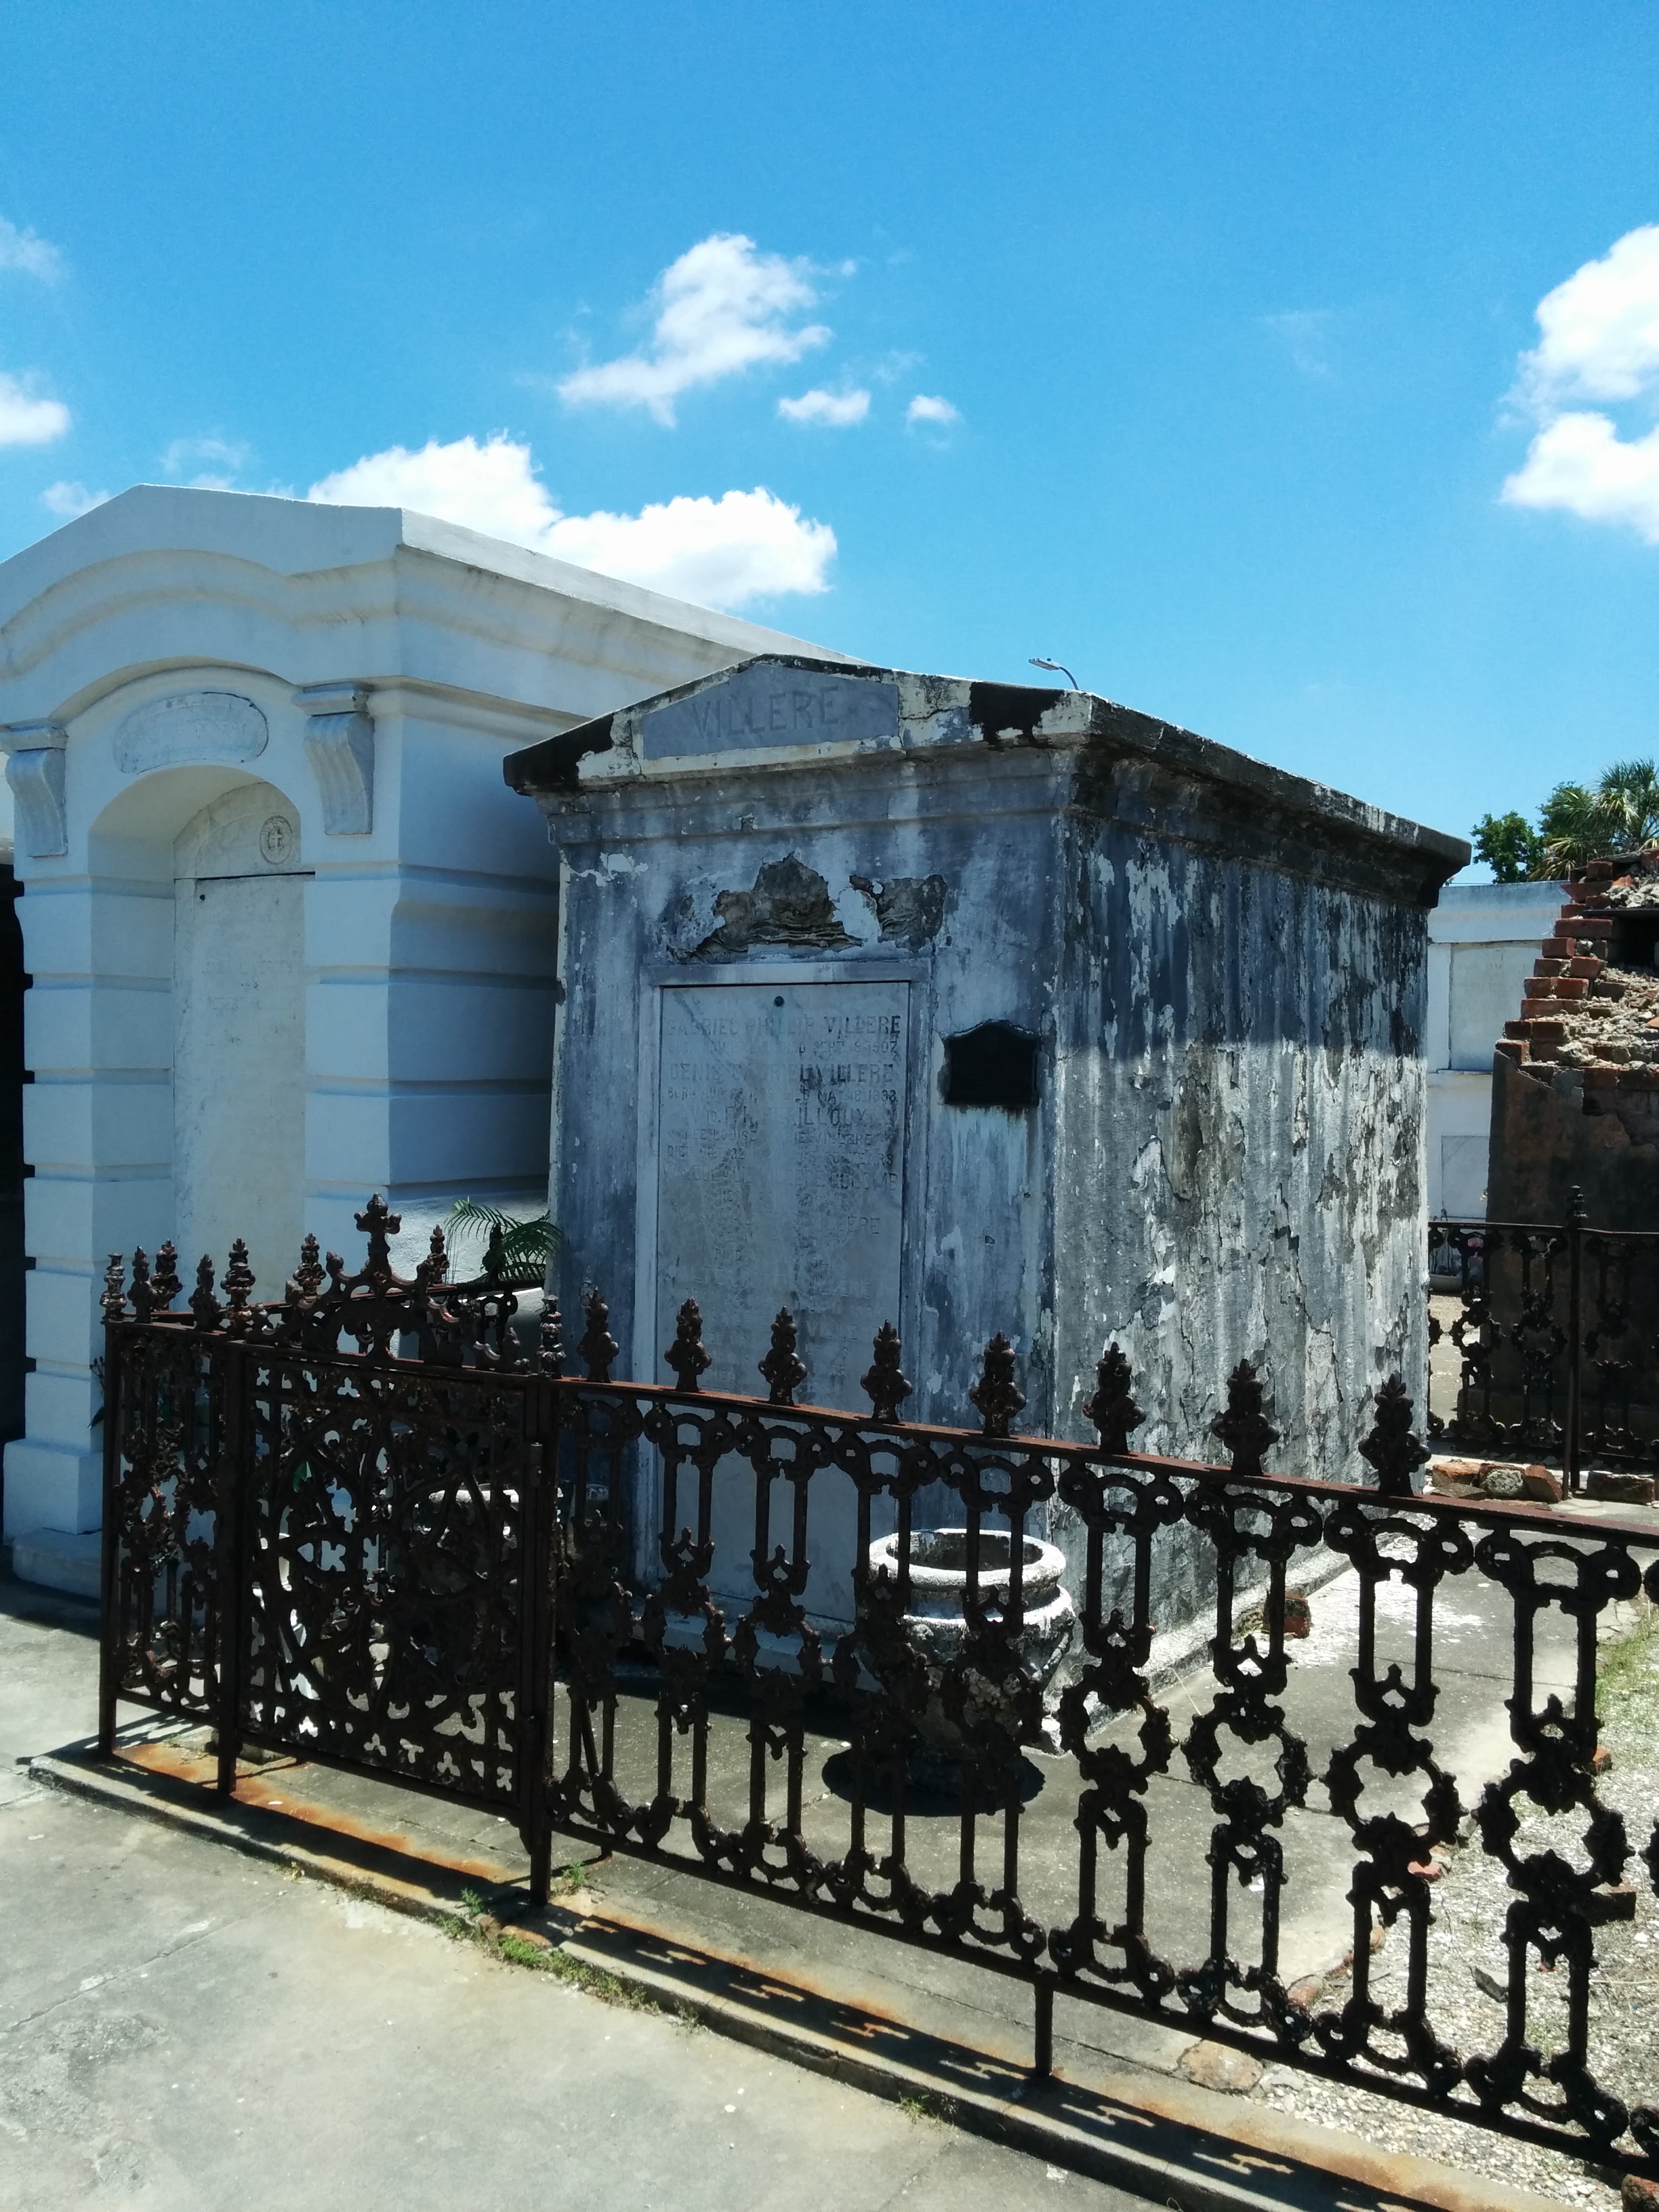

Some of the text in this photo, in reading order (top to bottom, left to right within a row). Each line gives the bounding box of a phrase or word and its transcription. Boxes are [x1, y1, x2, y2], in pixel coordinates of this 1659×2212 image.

[691, 685, 839, 739] VILLERE
[823, 1015, 900, 1035] VILLERE
[670, 1063, 720, 1082] DENIS
[815, 1063, 893, 1084] VILLERE
